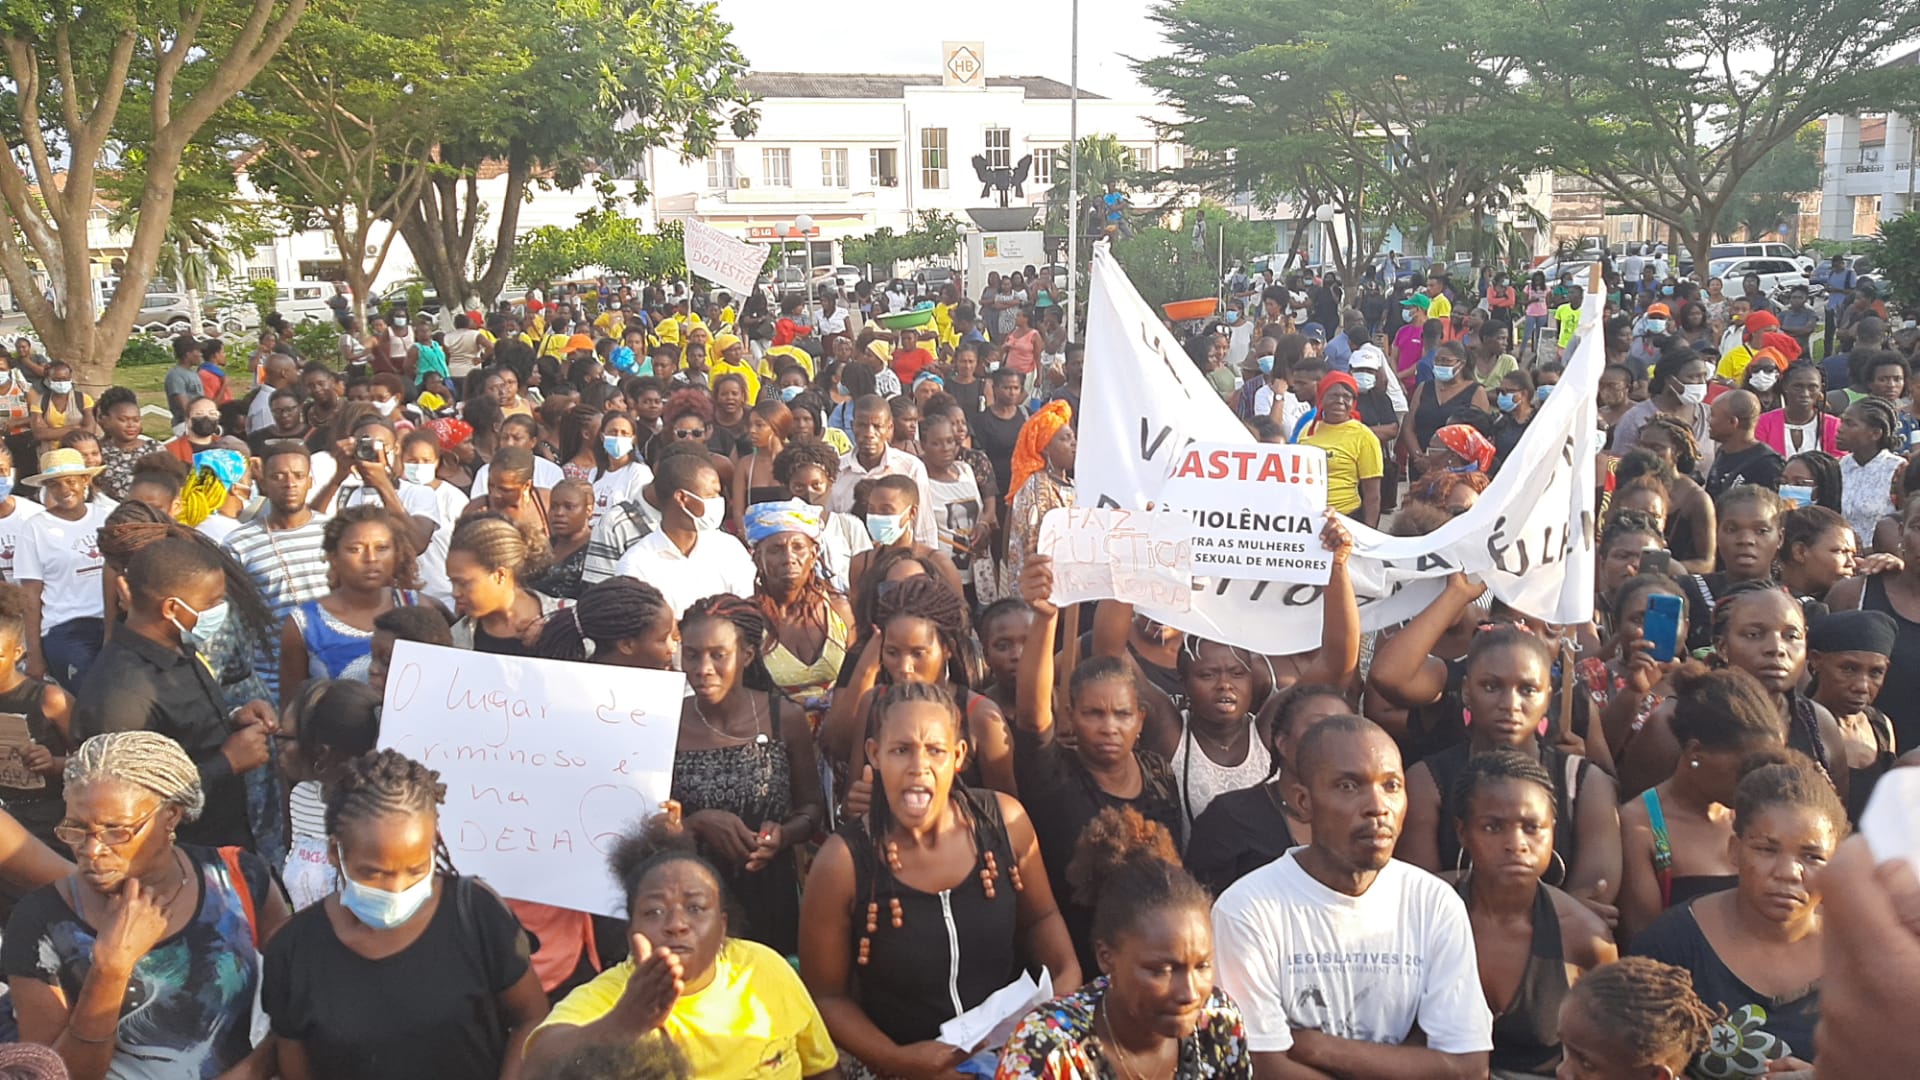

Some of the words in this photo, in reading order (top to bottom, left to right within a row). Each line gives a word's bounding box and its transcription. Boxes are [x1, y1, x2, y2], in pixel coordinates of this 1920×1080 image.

[955, 60, 974, 72] HB
[761, 228, 772, 236] LG
[1068, 506, 1135, 531] FAZ
[1218, 538, 1235, 548] AS
[1238, 539, 1306, 553] MULHERES
[1194, 553, 1242, 565] SEXUAL
[1246, 555, 1262, 567] DE
[1265, 557, 1327, 570] MENORES
[393, 663, 421, 712] O
[447, 667, 551, 748] lugar
[470, 783, 530, 806] na
[1287, 952, 1400, 966] LEGISLATIVES
